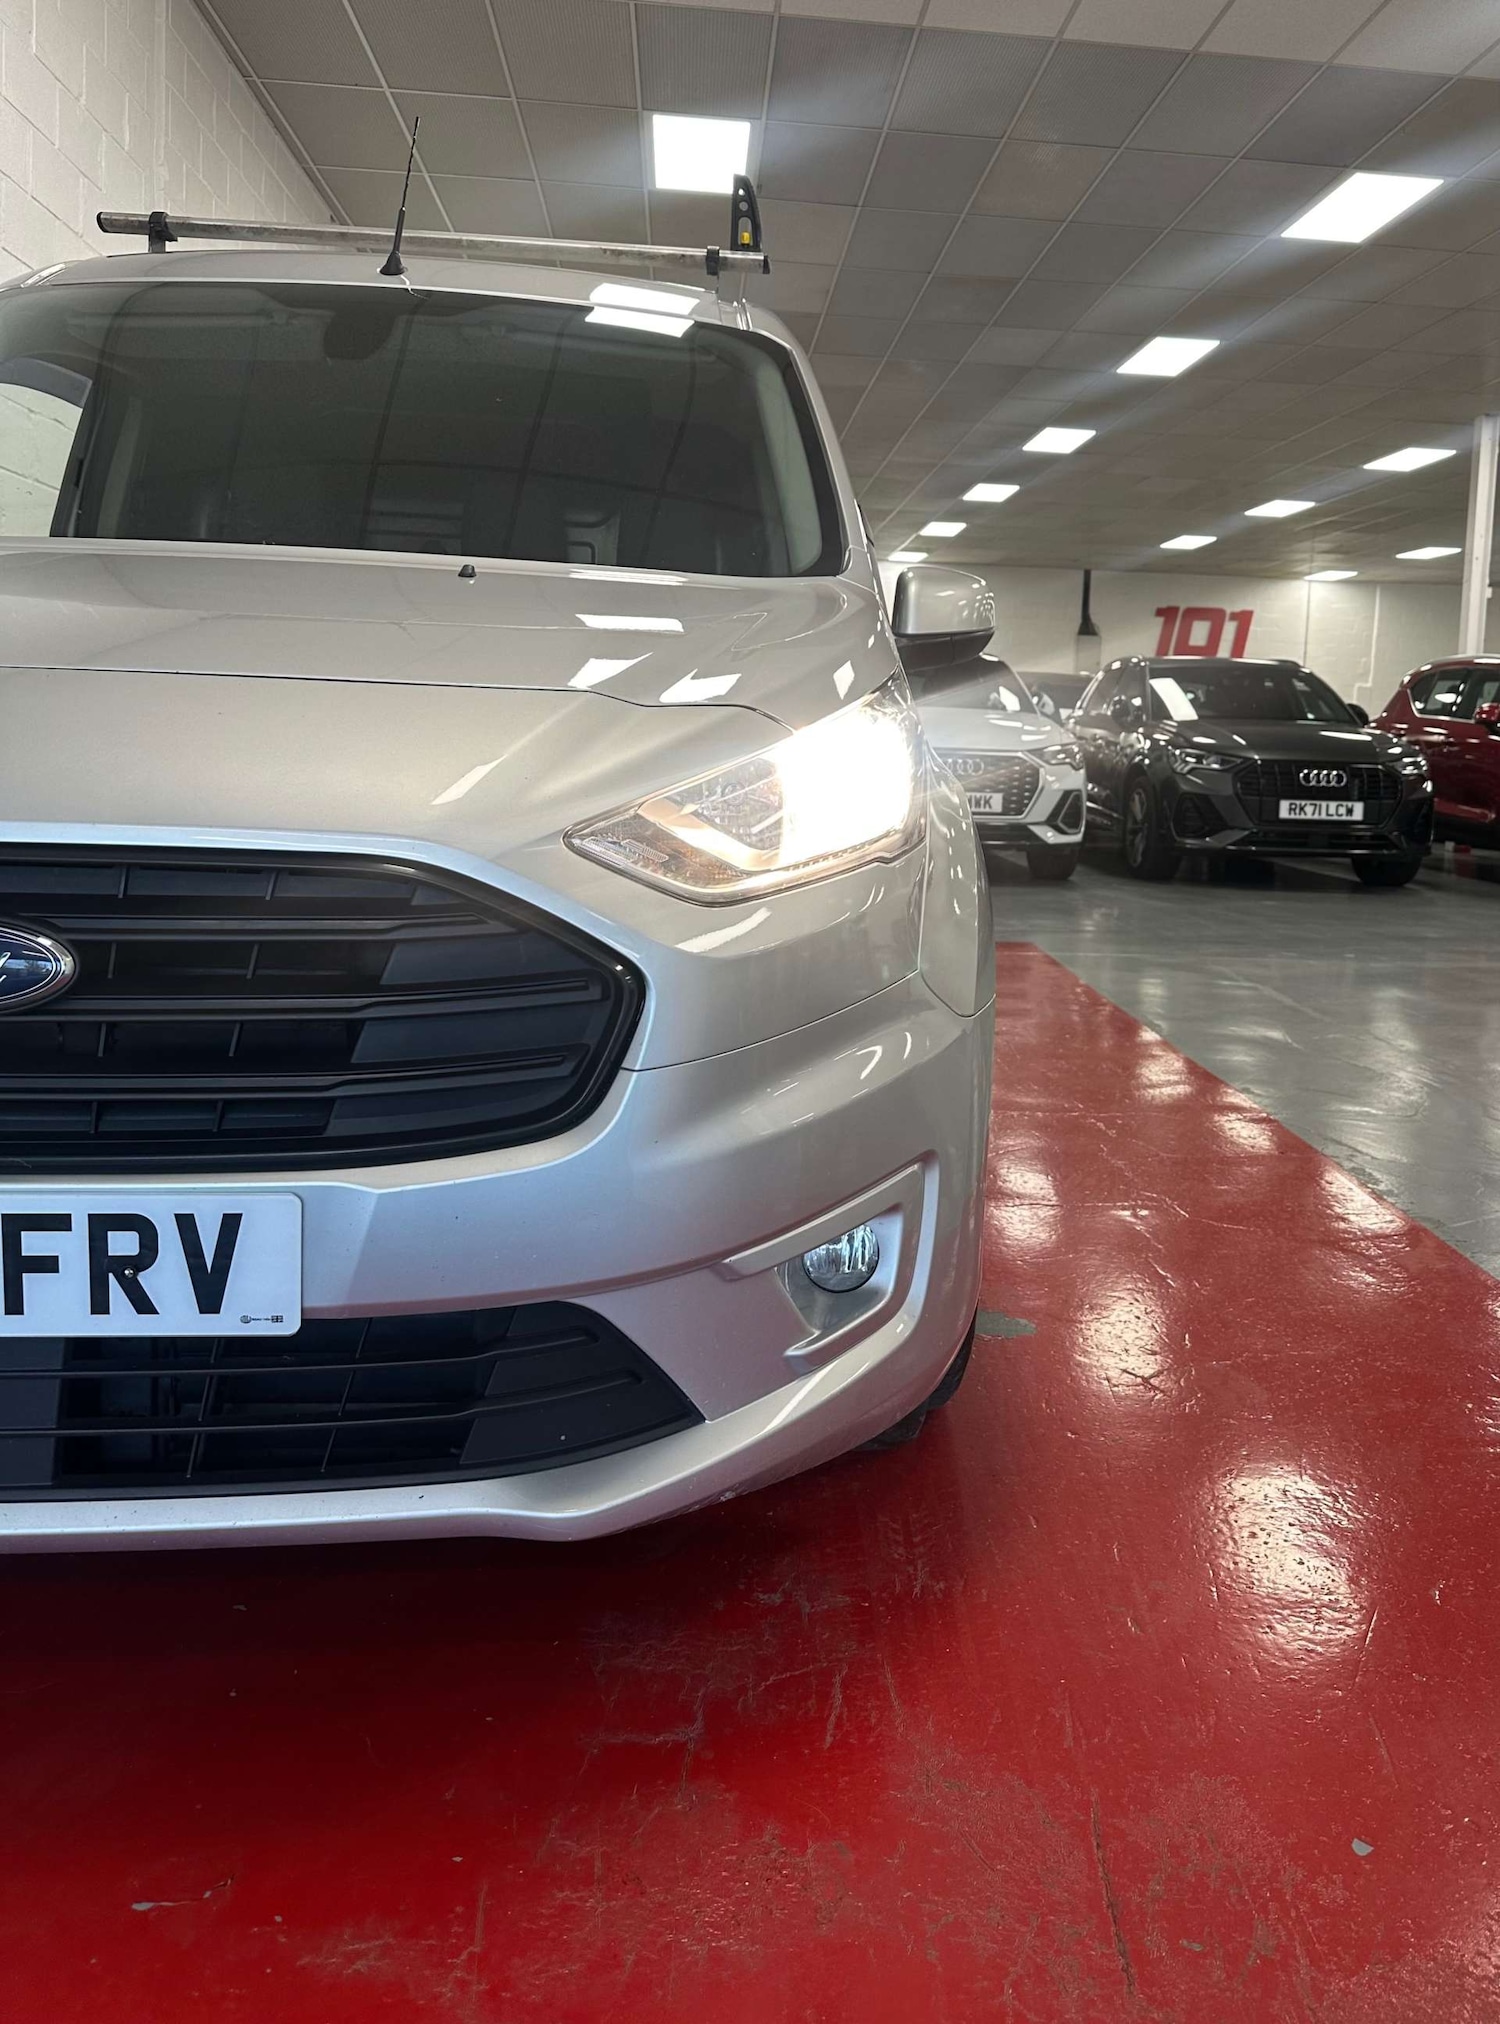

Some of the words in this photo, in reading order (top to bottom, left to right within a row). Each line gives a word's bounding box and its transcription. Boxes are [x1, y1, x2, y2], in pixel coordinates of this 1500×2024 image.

[1154, 606, 1254, 659] 101
[1288, 802, 1322, 817] RK71
[1325, 803, 1355, 818] LCW
[1, 1212, 243, 1315] FRV
